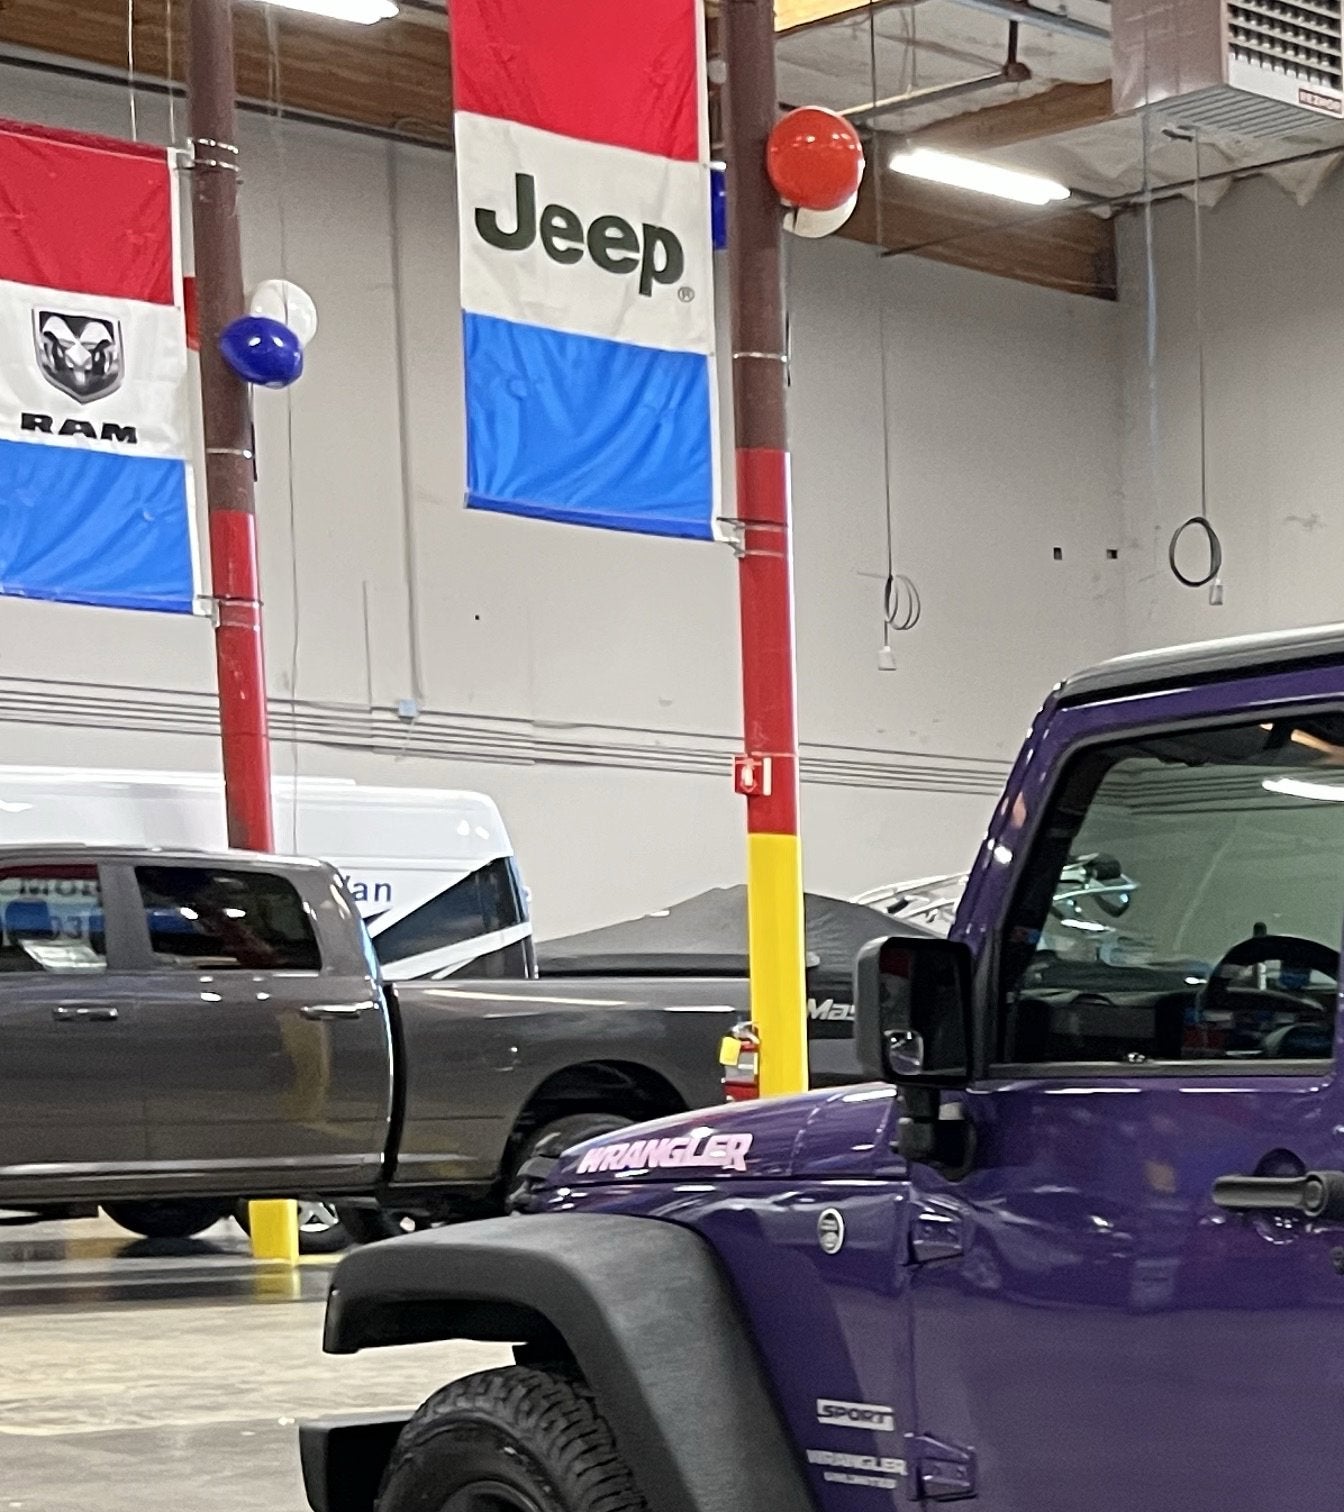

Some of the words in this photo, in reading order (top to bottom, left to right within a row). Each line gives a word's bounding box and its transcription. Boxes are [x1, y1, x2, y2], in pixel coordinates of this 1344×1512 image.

[475, 173, 684, 297] Jeep
[21, 412, 138, 444] RAM
[576, 1133, 753, 1173] WRANGLER
[816, 1401, 895, 1427] SPORT
